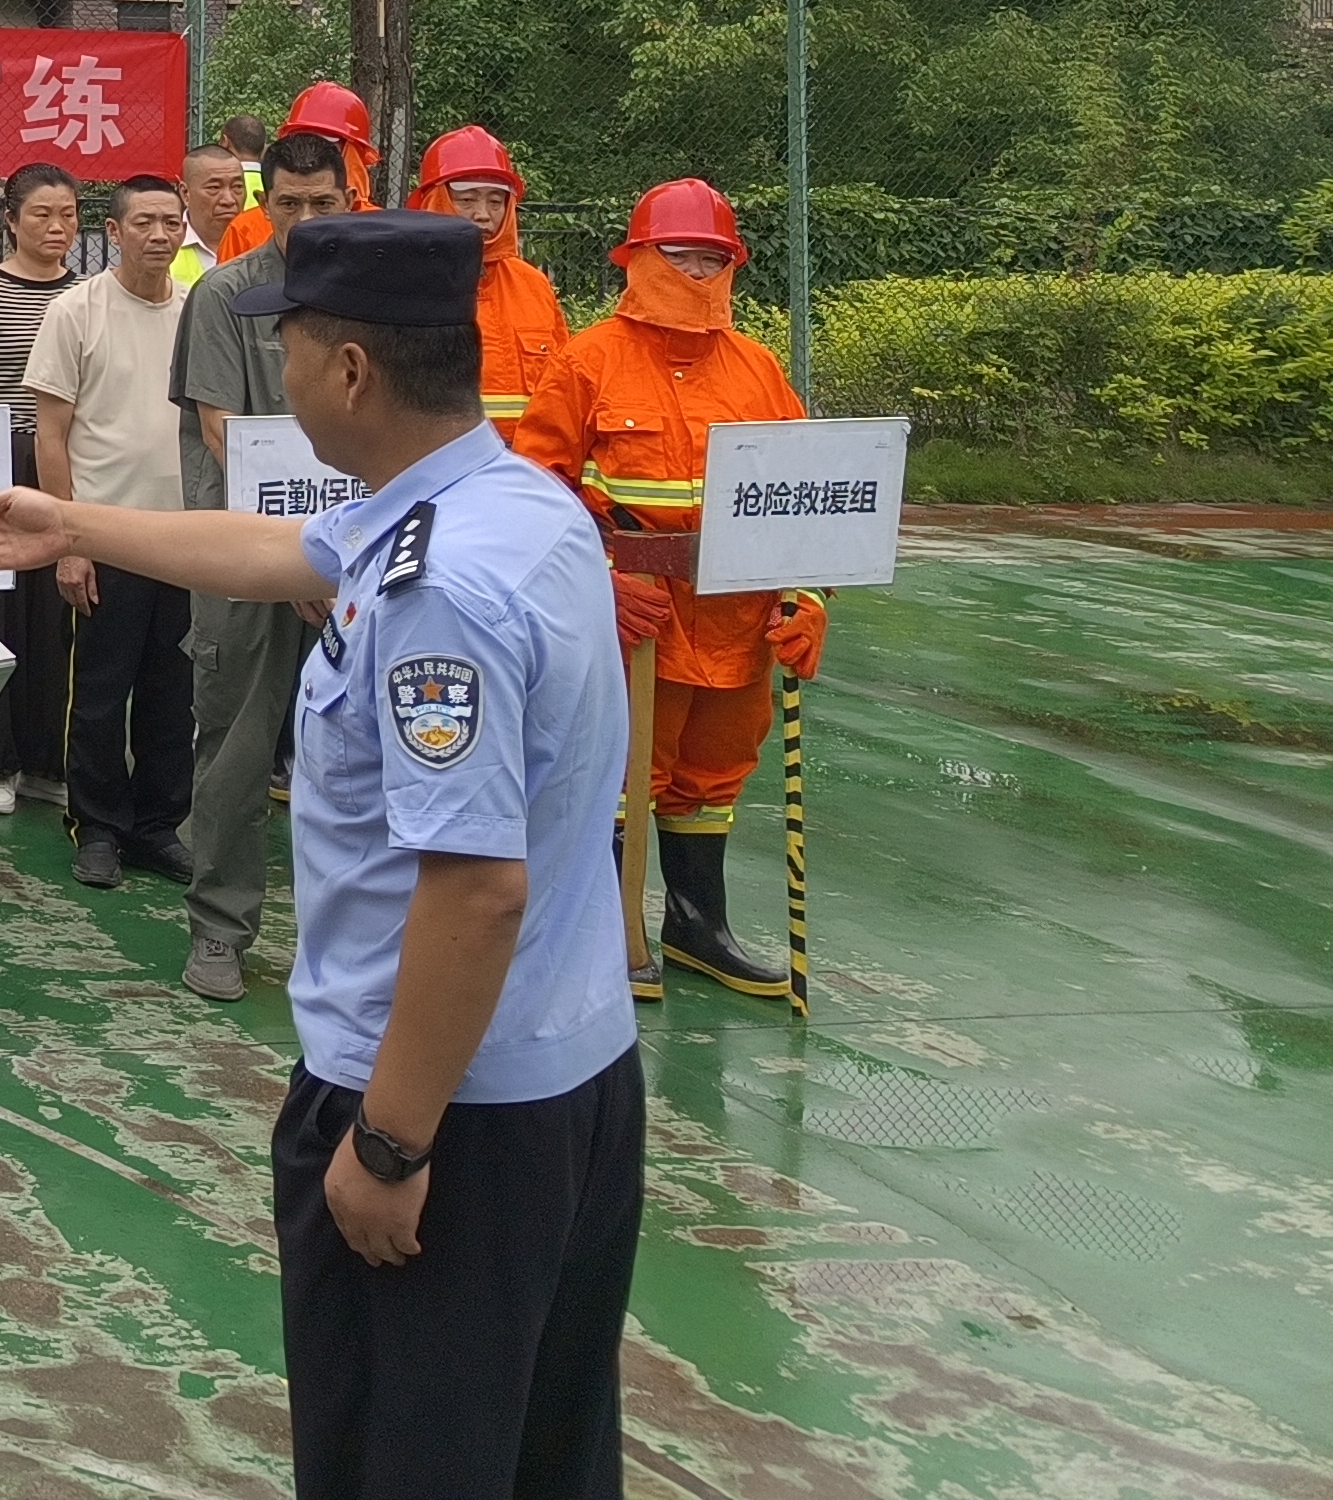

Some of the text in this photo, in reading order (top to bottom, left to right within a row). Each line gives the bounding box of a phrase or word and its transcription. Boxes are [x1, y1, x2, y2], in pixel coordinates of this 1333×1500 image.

[732, 480, 878, 518] 抢险救援组
[392, 661, 474, 684] 中华人民共和国
